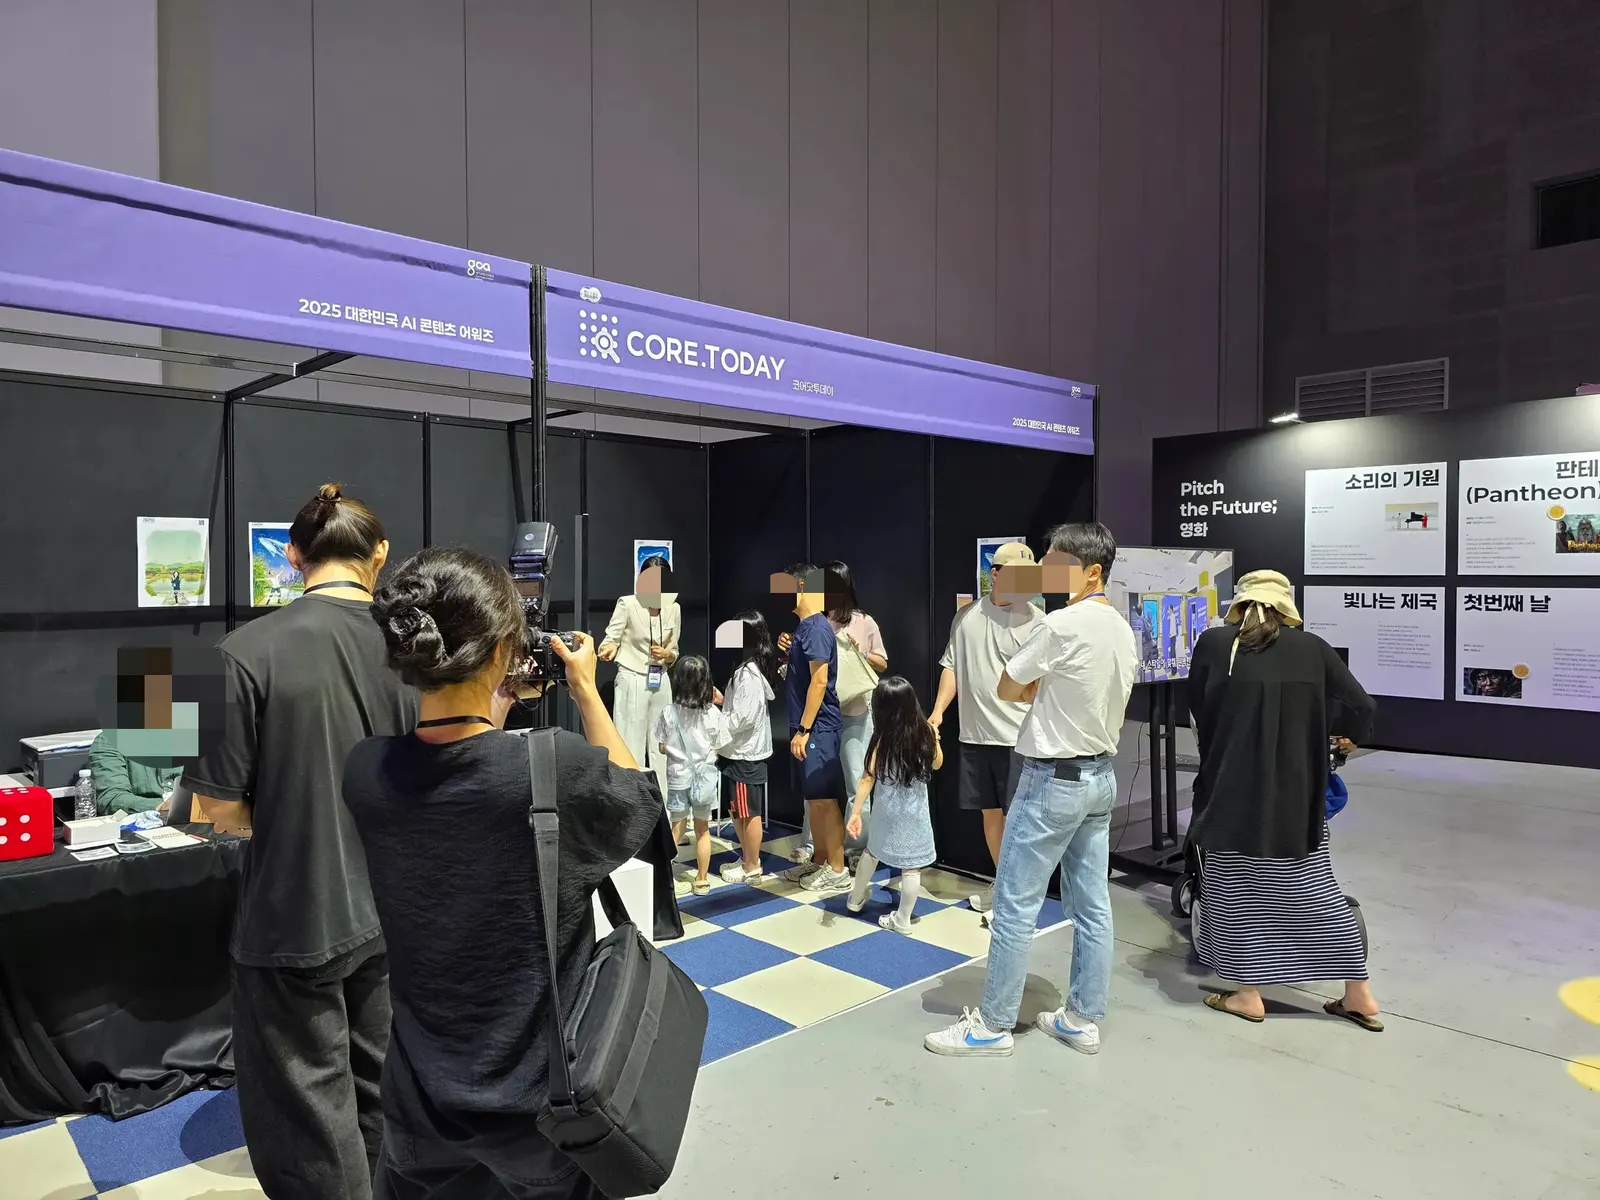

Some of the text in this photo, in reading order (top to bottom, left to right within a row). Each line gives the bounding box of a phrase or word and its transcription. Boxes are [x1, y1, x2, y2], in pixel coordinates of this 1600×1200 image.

[299, 298, 495, 343] 2025 대한민국 AI 콘텐츠 어워즈
[627, 330, 786, 380] CORE.TODAY
[792, 379, 834, 397] 코어닷투데이
[1012, 417, 1027, 428] 2025
[1028, 419, 1046, 431] 대한민국
[1047, 422, 1053, 431] AI
[1556, 459, 1599, 479] 판테
[1180, 479, 1225, 496] Pitch
[1345, 468, 1440, 490] 소리의 기원
[1179, 498, 1278, 517] the Future;
[1179, 521, 1209, 538] 영화
[1344, 592, 1438, 611] 빛나는 제국
[1463, 594, 1551, 613] 첫번째 날
